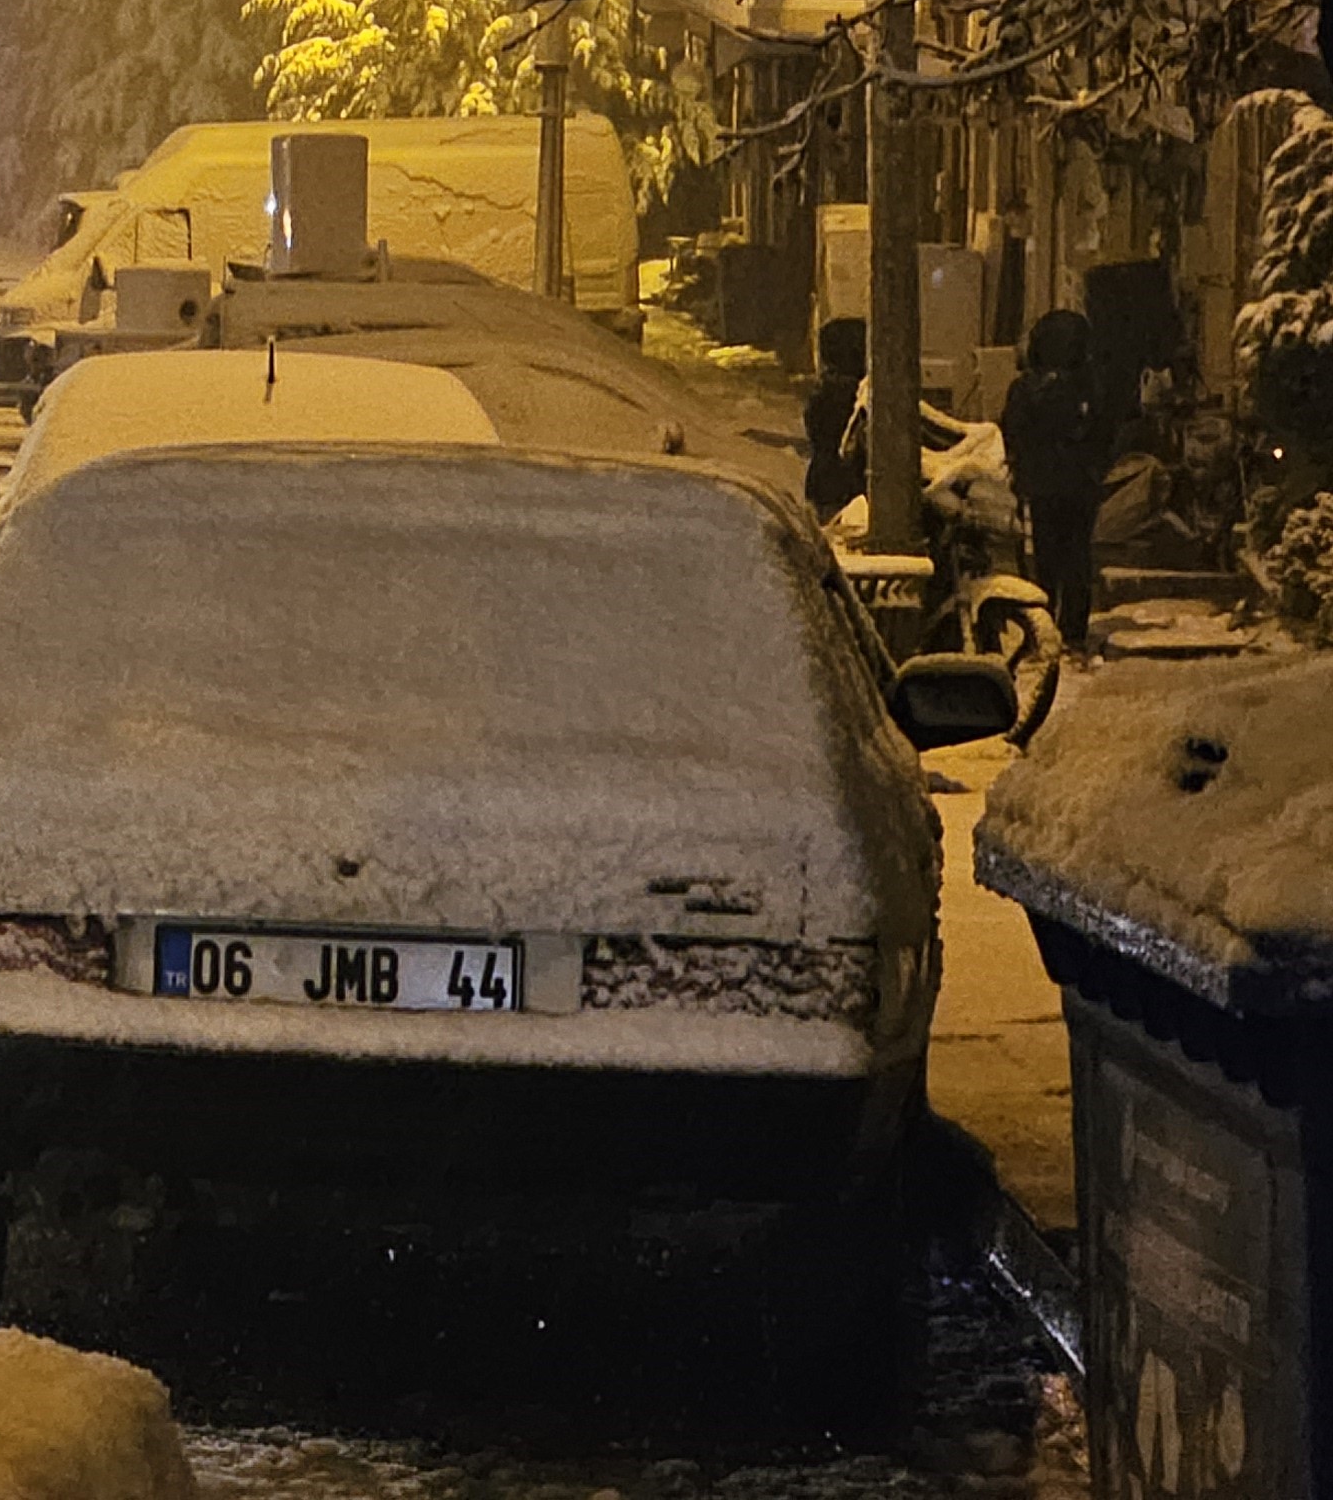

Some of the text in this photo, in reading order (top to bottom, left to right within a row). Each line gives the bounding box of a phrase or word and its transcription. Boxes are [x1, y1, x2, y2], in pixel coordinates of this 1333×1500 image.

[165, 939, 507, 1009] TR 06 JMB 44
